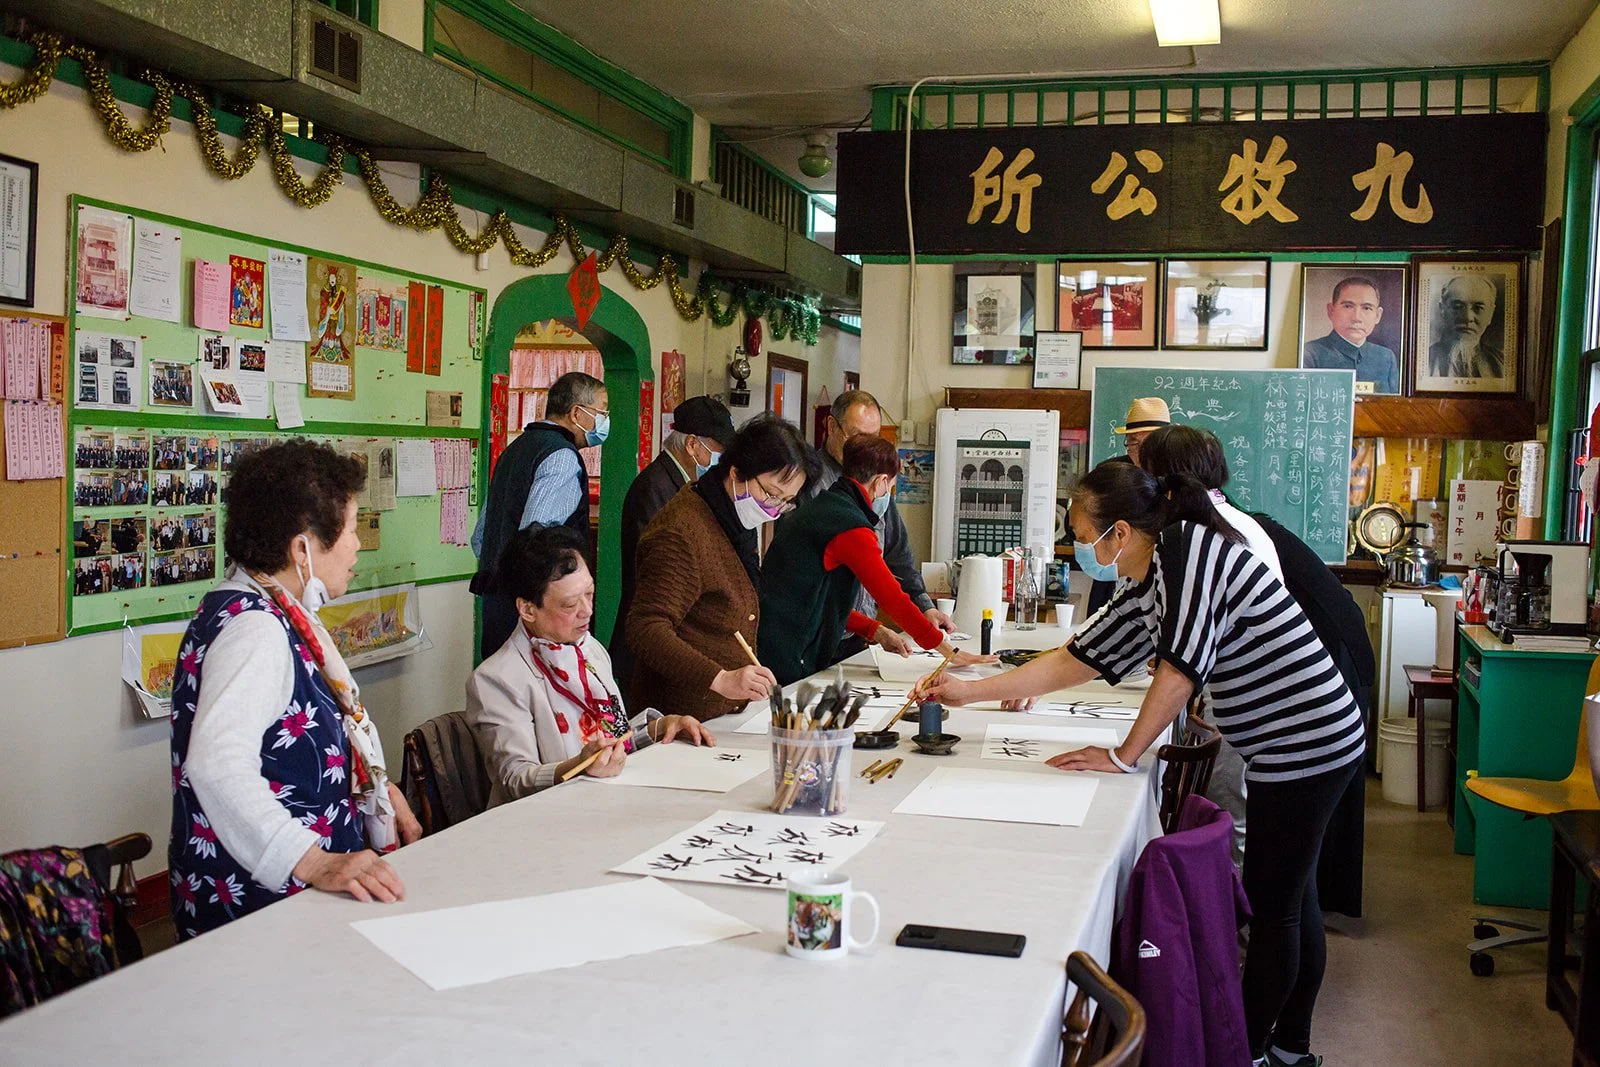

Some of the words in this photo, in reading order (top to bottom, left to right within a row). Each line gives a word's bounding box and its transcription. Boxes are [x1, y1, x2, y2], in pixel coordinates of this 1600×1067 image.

[965, 134, 1434, 233] 九牧公所
[1264, 379, 1288, 397] 林
[1228, 435, 1250, 510] 祝各位宗
